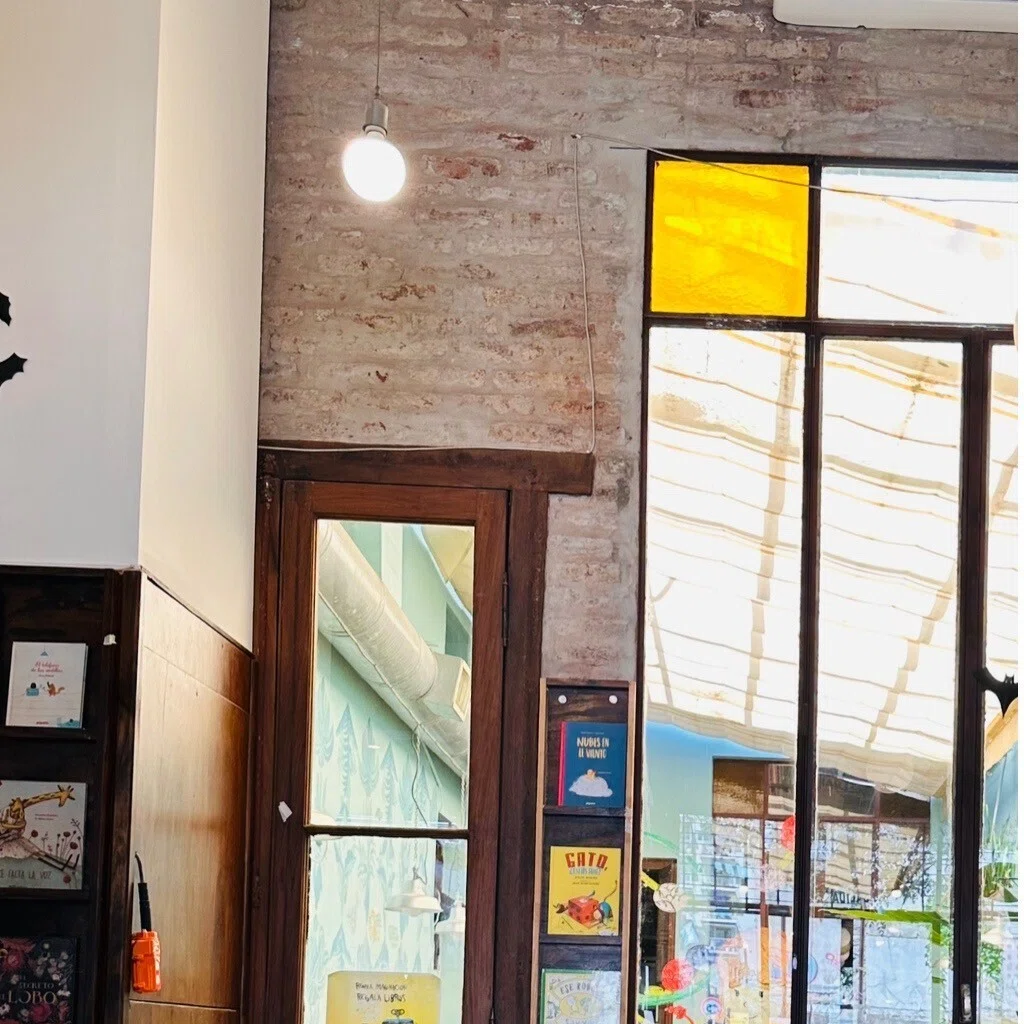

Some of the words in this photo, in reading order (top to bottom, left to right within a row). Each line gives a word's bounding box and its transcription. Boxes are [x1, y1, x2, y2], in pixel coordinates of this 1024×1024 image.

[576, 737, 600, 747] NUBES
[602, 737, 610, 747] EN
[586, 748, 607, 759] VIENTO
[564, 851, 608, 872] GATO,
[19, 981, 54, 989] SECRETO
[8, 989, 58, 1005] LOBO
